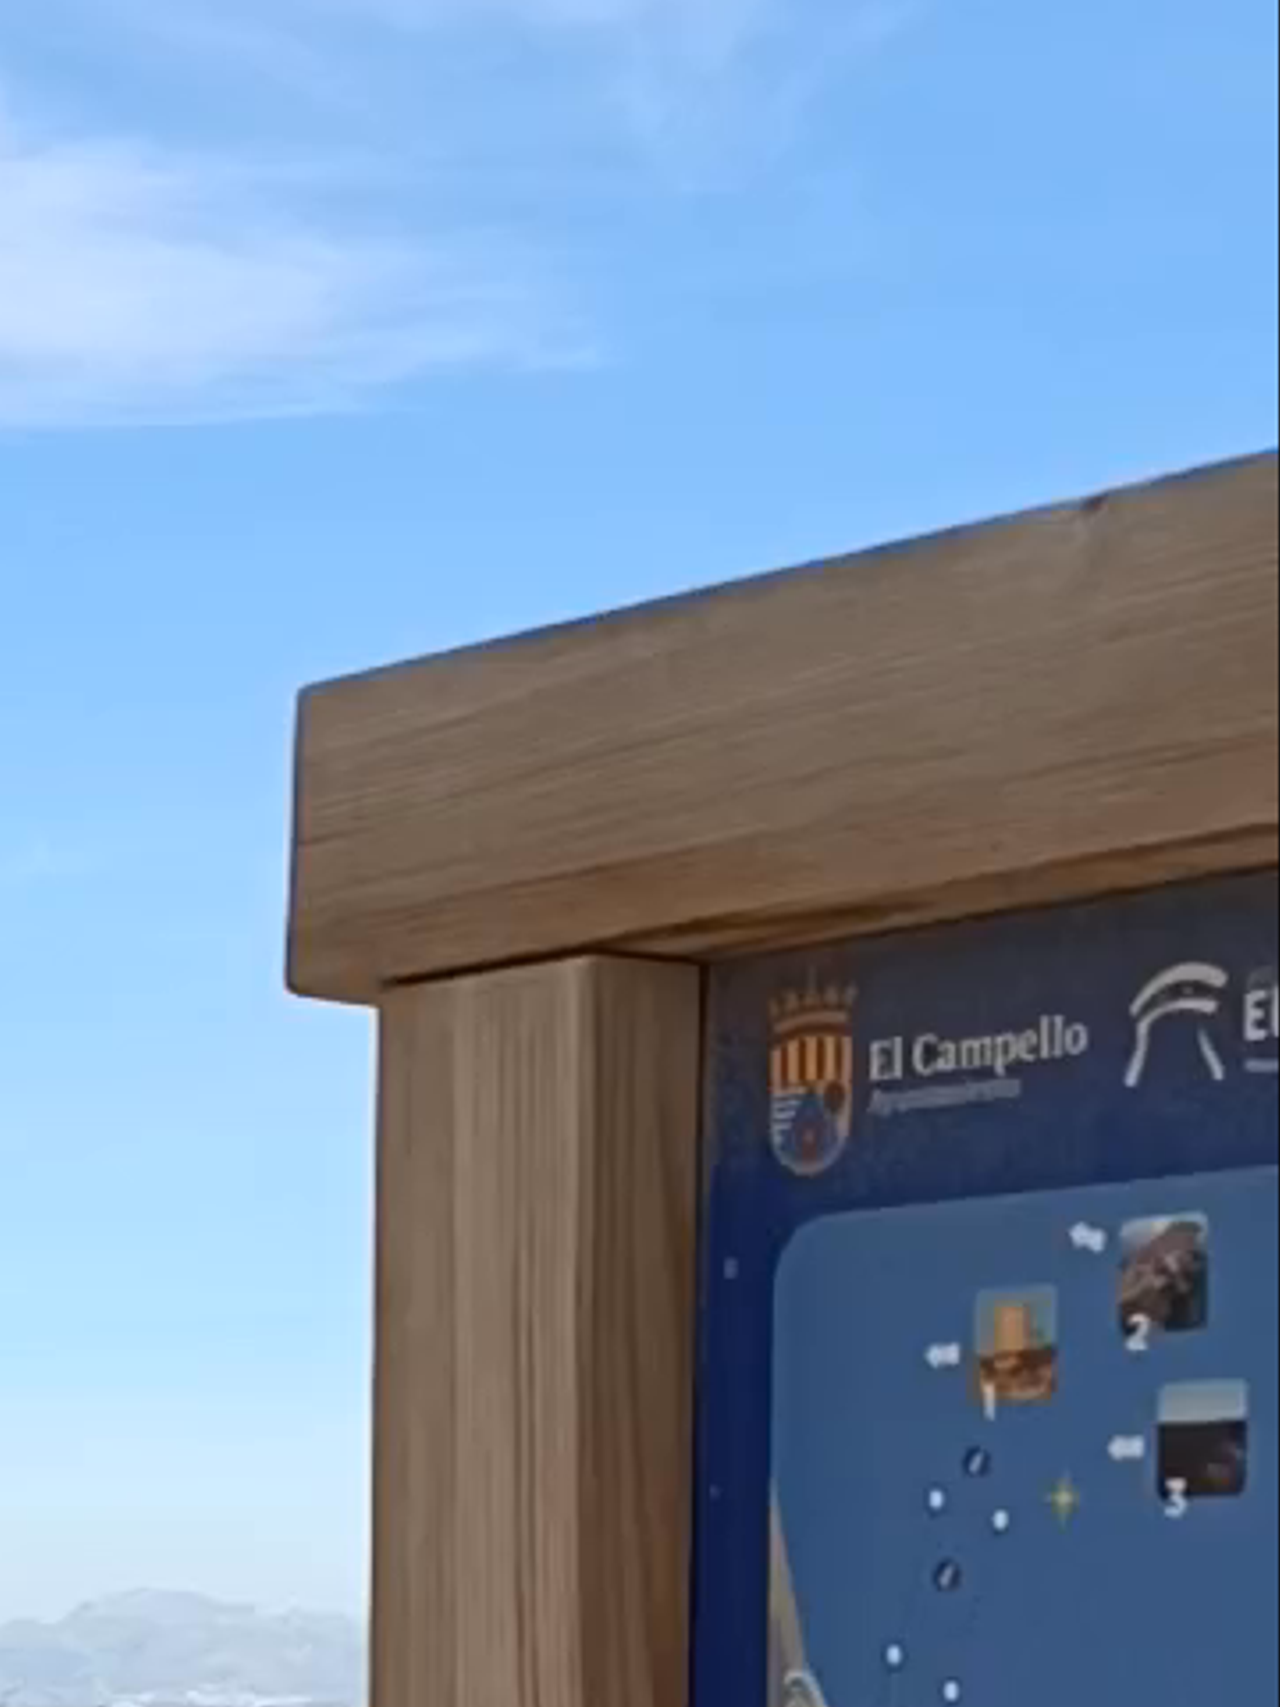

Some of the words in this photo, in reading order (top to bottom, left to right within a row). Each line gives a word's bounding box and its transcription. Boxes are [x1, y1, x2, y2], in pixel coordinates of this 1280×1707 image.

[869, 1036, 903, 1080] El
[911, 1014, 1088, 1077] Campello
[1126, 1312, 1150, 1351] 2
